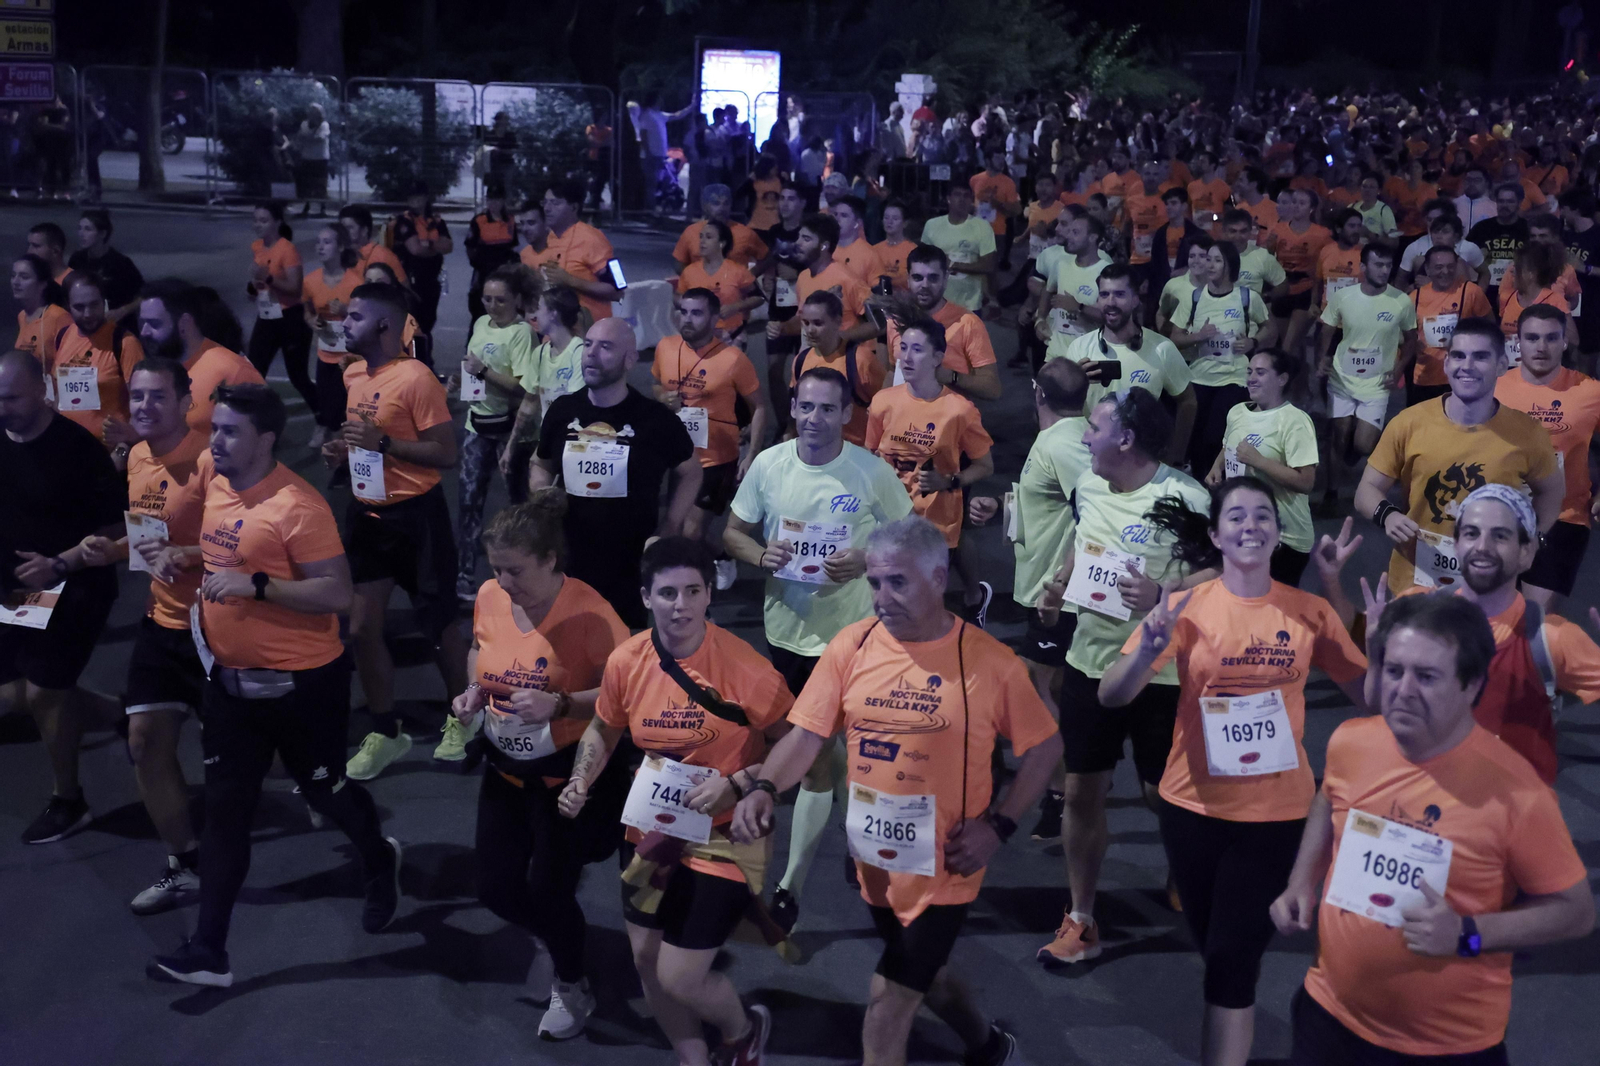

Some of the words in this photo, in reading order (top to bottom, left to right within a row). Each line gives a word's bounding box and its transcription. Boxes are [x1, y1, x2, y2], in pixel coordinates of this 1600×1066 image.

[7, 37, 49, 53] Armas
[5, 83, 49, 98] Sevilla
[1376, 312, 1395, 322] Fili
[1351, 357, 1375, 366] 18149
[1129, 369, 1152, 384] Fili
[65, 382, 90, 393] 19675
[353, 462, 372, 478] 4288
[577, 460, 614, 476] 12881
[829, 494, 861, 514] Fili
[1120, 524, 1151, 544] Fili
[793, 540, 837, 559] 18142
[1433, 553, 1461, 571] 380
[1244, 647, 1296, 657] NOCTURNA
[1220, 657, 1266, 666] SEVILLA
[482, 671, 522, 688] SEVILLA
[503, 669, 551, 683] NOCTURNA
[864, 697, 910, 710] SEVILLA
[889, 690, 942, 704] NOCTURNA
[660, 710, 706, 719] NOCTURNA
[642, 718, 679, 729] SEVILLA
[1222, 719, 1276, 743] 16979
[497, 736, 534, 752] 5856
[651, 781, 689, 806] 744
[863, 814, 916, 842] 21866
[1363, 850, 1424, 890] 16986
